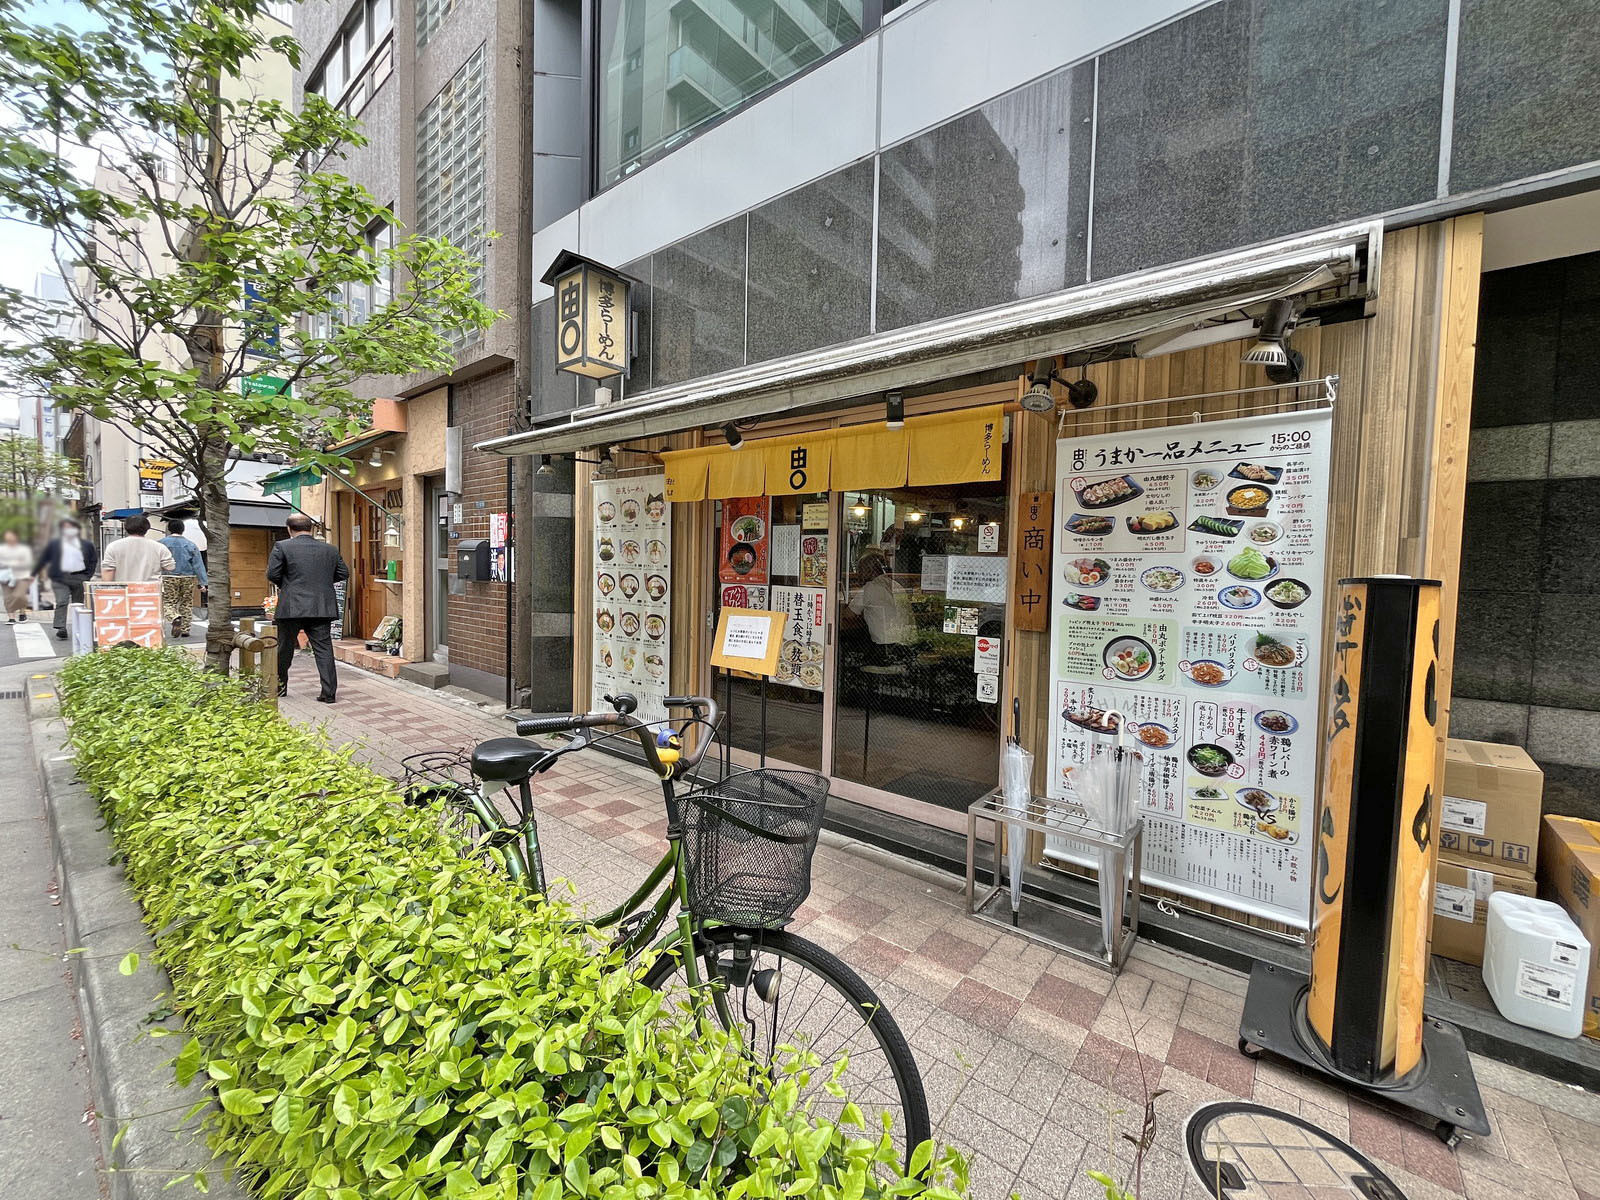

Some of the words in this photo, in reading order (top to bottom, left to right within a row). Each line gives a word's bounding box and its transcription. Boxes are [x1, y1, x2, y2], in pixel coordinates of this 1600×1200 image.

[981, 423, 994, 475] 博多らーめん
[1095, 439, 1265, 467] うまか一品メニュー
[1271, 430, 1311, 444] 15:00
[1019, 526, 1046, 614] 商い中
[790, 592, 805, 678] 替玉食べ放題
[1158, 624, 1168, 681] 由丸ポテトサラダ
[1227, 708, 1235, 735] 500円
[1235, 708, 1247, 757] 牛すじ煮込み
[1268, 736, 1280, 779] 赤ワイン煮
[1280, 737, 1292, 777] 鶏レバーの
[1288, 798, 1296, 821] から揚げ
